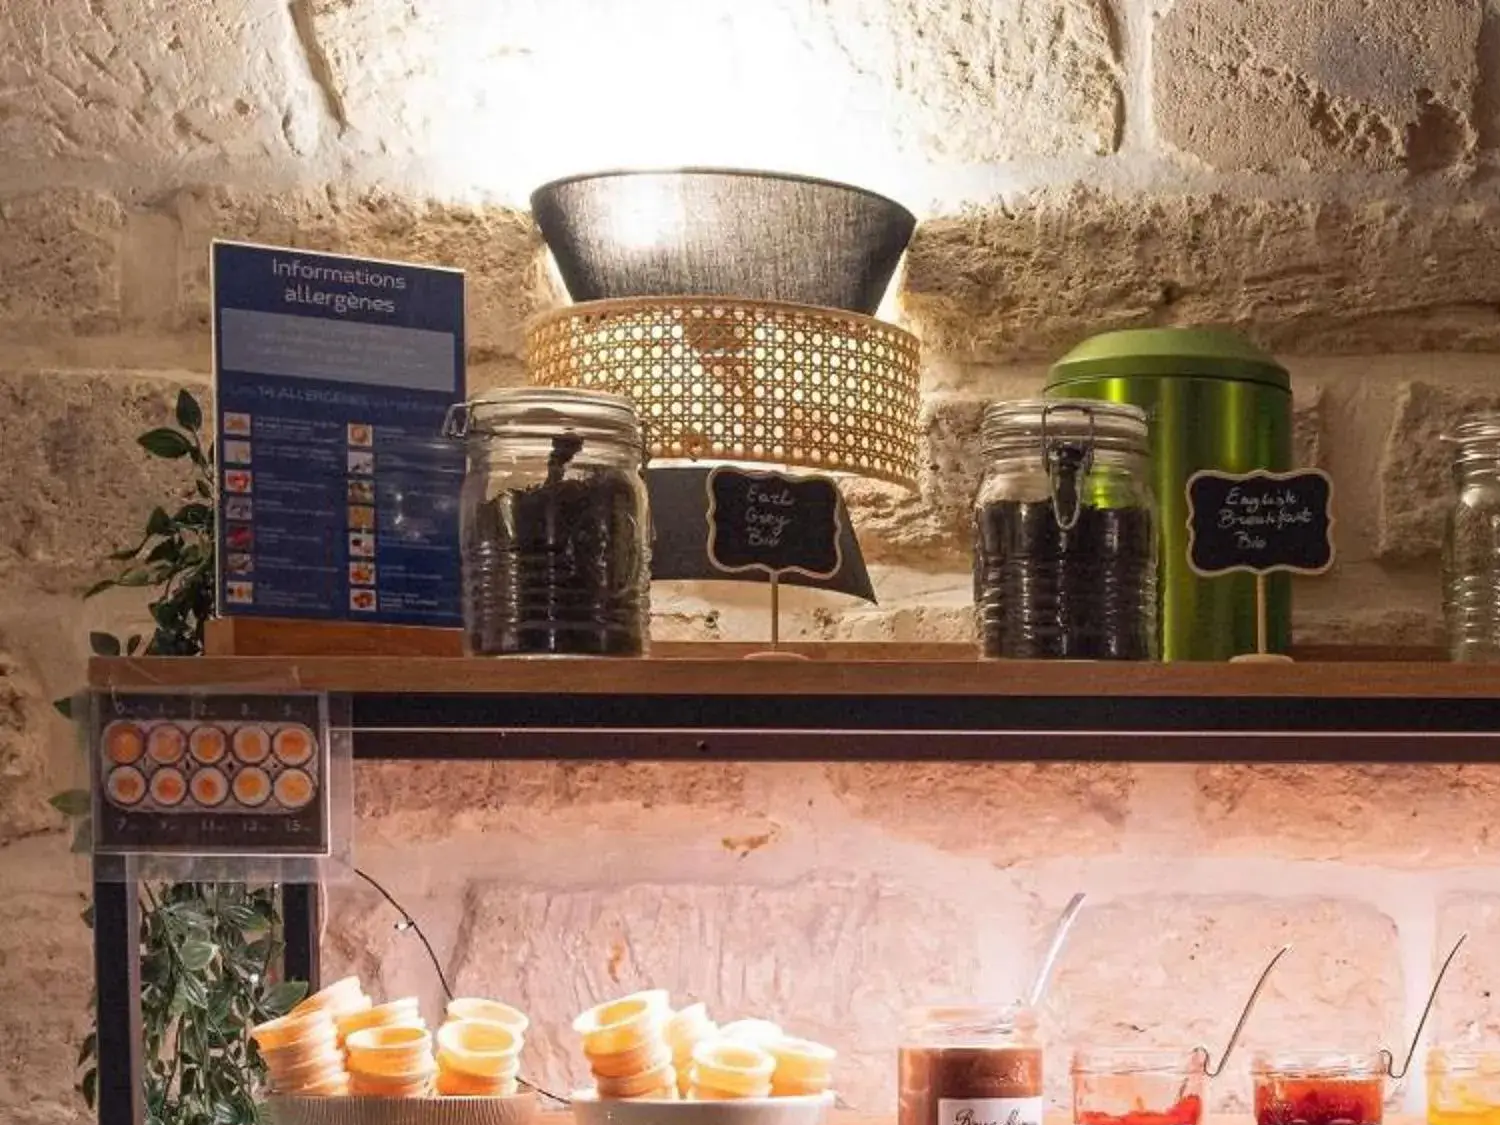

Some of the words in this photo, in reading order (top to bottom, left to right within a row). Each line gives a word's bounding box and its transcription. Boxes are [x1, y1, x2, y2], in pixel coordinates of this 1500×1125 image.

[272, 256, 406, 289] Informations
[285, 285, 395, 313] allergènes
[747, 483, 795, 505] Earl
[1225, 487, 1298, 513] English
[745, 506, 792, 534] Grey
[1217, 507, 1313, 530] Breakfast
[1234, 531, 1268, 549] Bio
